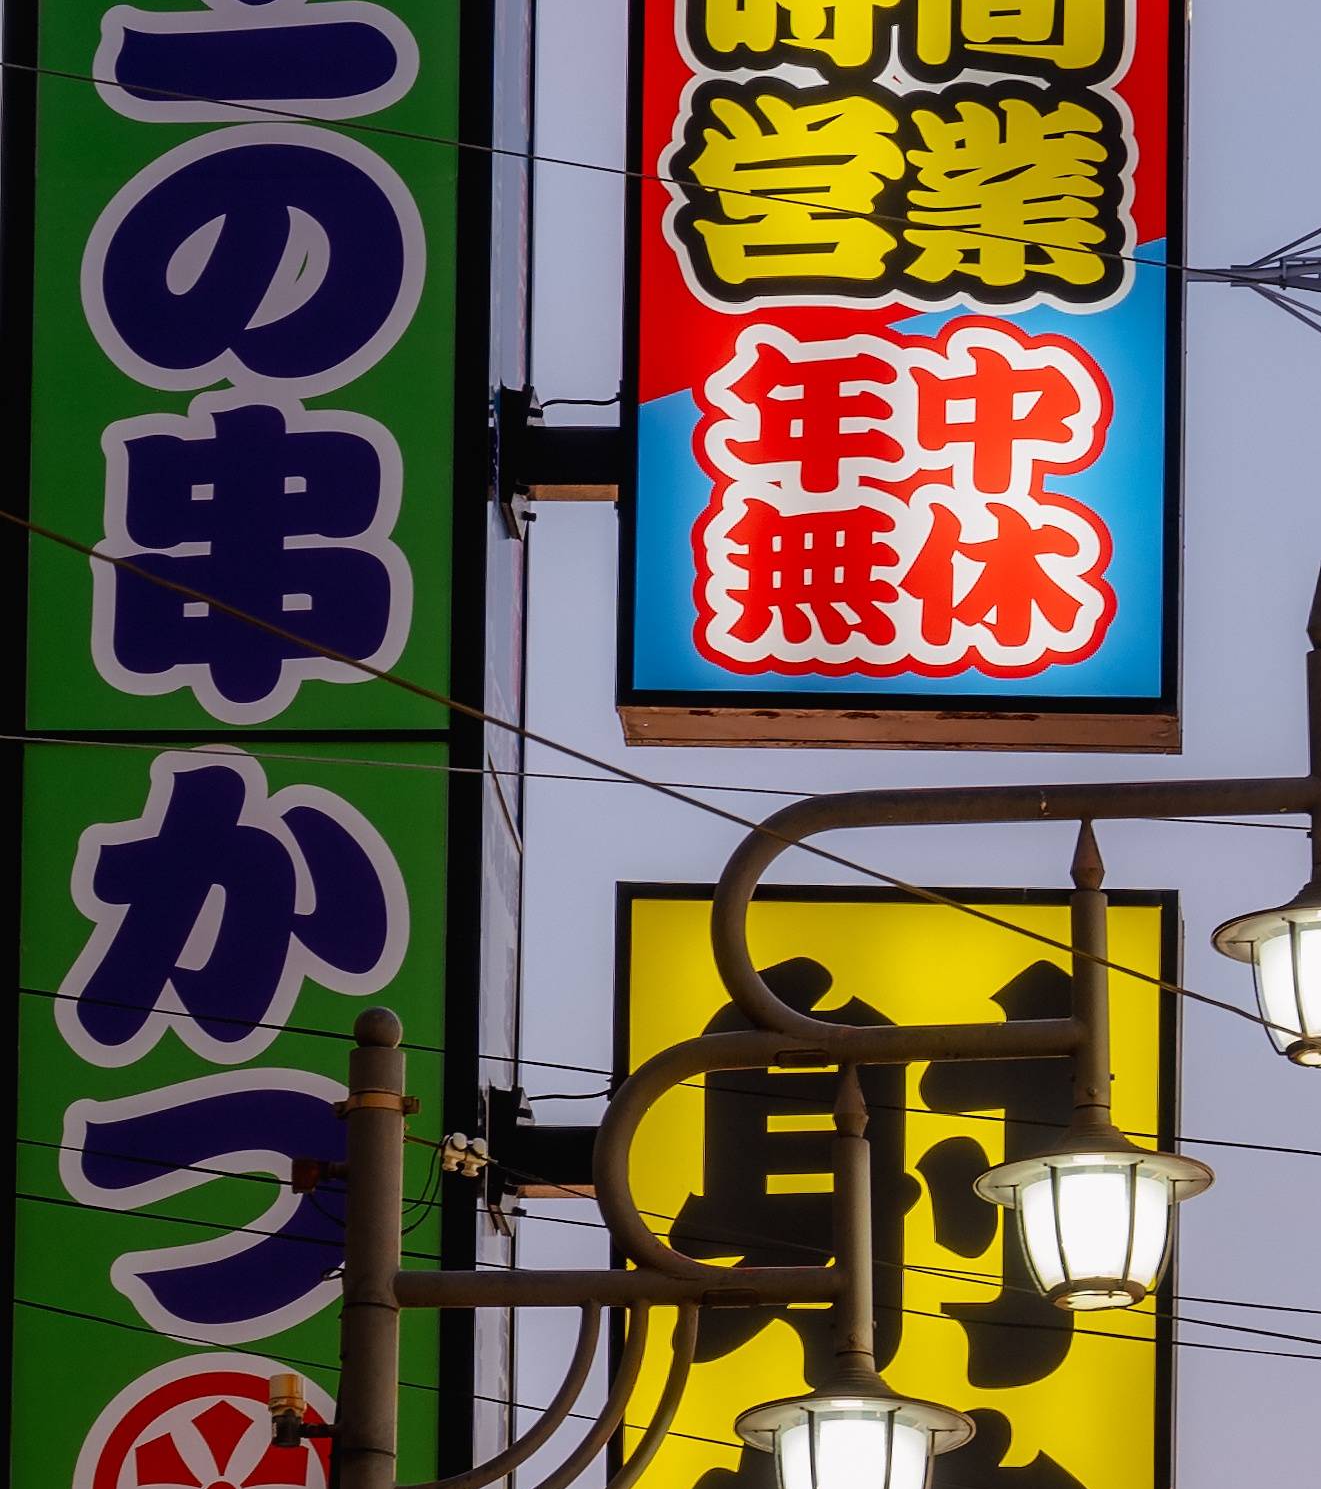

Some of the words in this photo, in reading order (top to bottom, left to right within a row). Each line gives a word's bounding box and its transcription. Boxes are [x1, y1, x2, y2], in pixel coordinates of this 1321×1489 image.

[668, 80, 1129, 306] 営業
[726, 338, 1088, 498] 年中
[725, 498, 1088, 656] 無休
